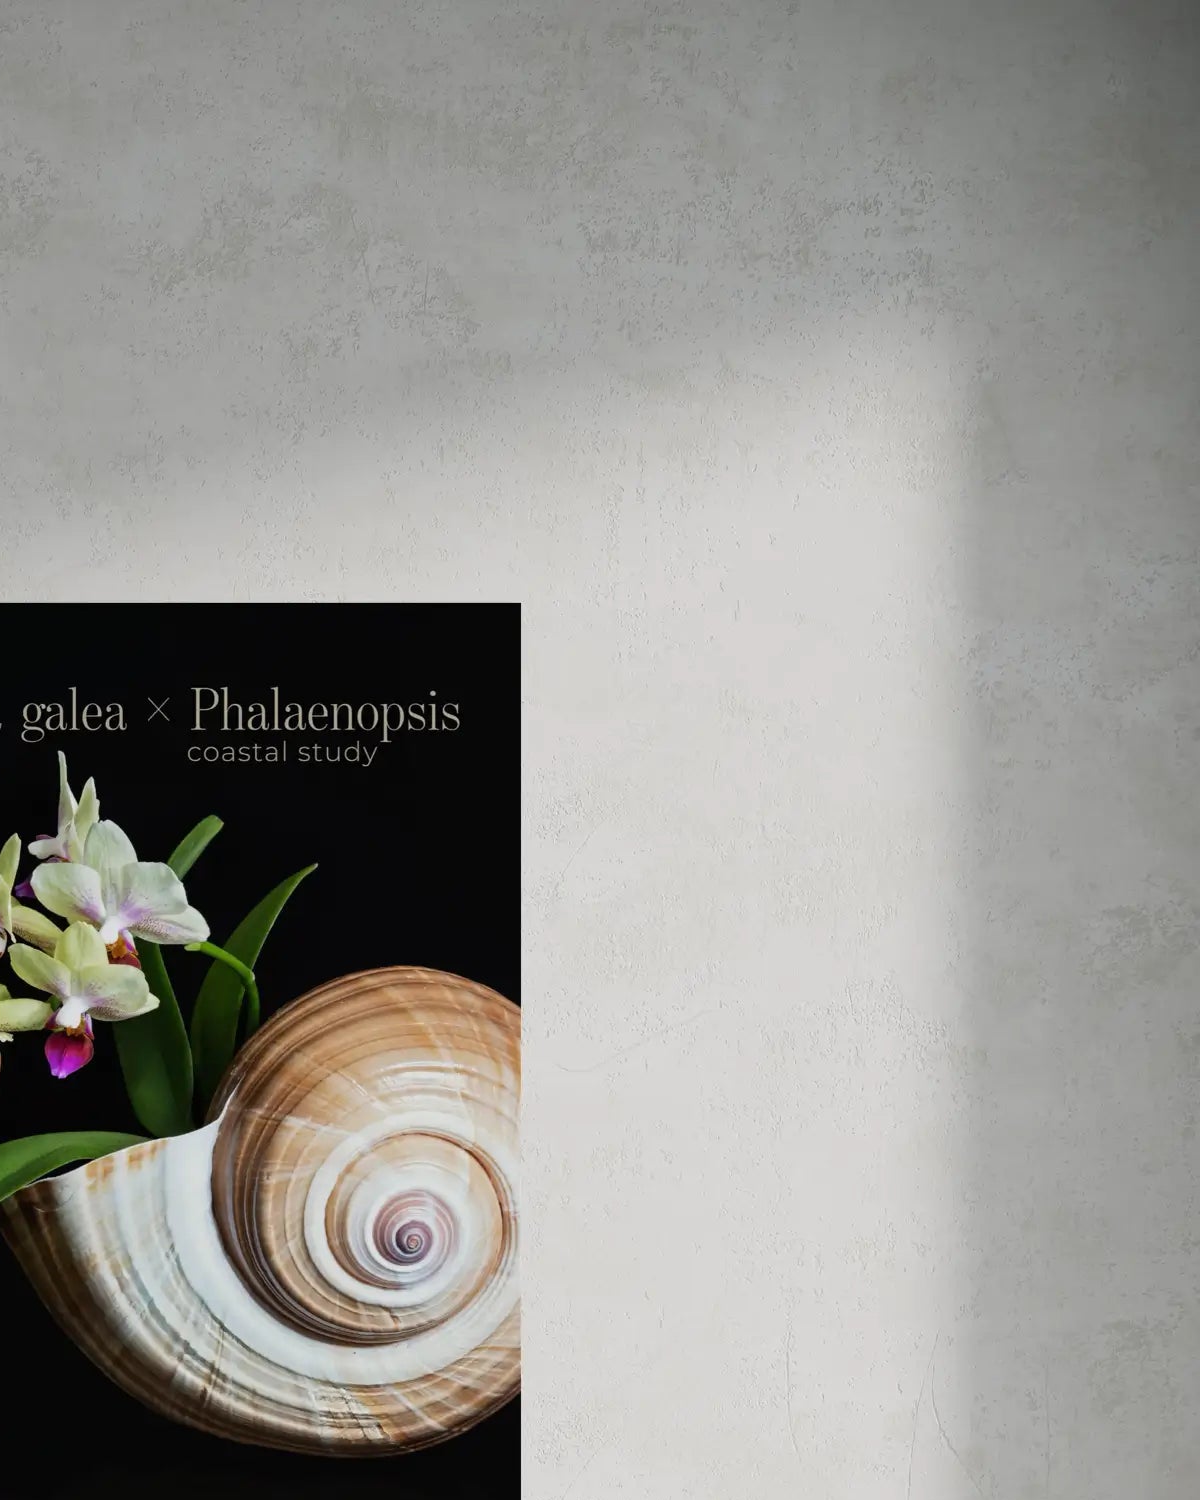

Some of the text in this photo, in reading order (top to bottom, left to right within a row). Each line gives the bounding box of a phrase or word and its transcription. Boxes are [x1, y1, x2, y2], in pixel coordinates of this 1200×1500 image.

[20, 687, 128, 743] galea
[190, 687, 461, 743] Phalaenopsis
[187, 740, 379, 767] coastal study
